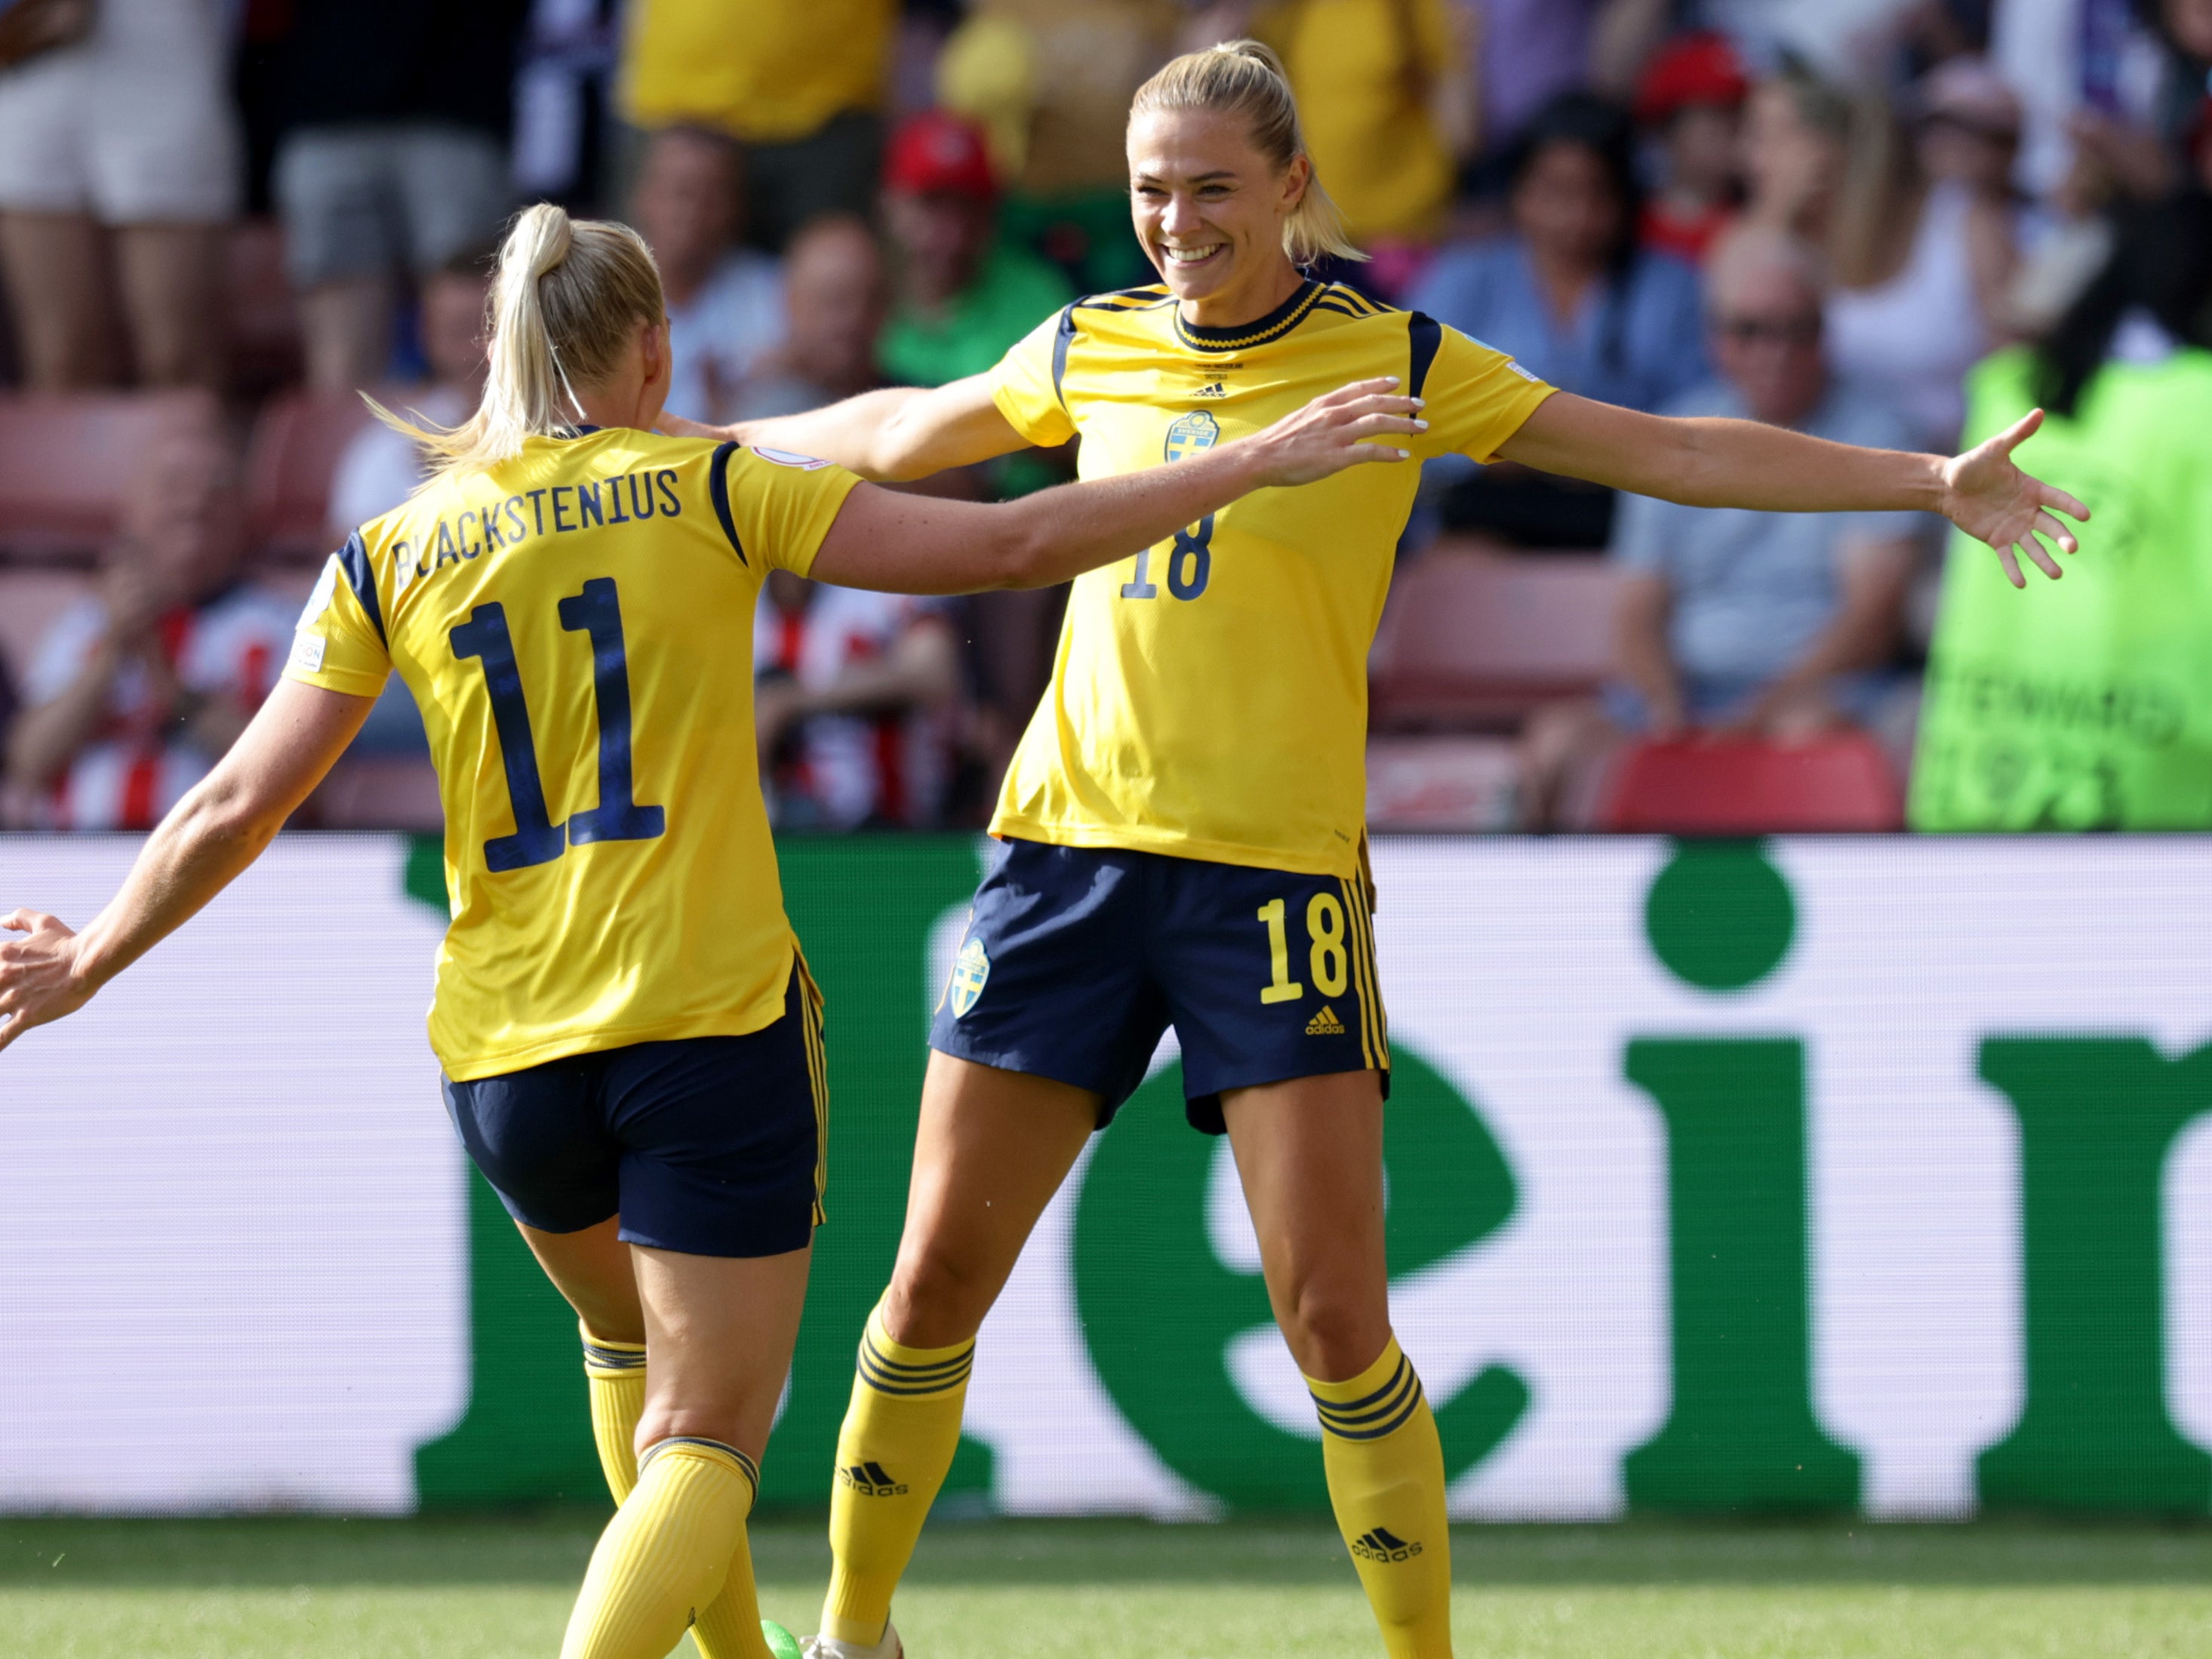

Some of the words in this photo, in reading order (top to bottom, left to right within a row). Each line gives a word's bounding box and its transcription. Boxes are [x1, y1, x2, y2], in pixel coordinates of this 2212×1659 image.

[1177, 428, 1210, 438] SVERIGE
[392, 469, 681, 589] BLACKSTENIUS
[1121, 513, 1215, 602] 18
[449, 577, 666, 873] 11
[1257, 892, 1347, 1005] 18
[1305, 1024, 1345, 1035] adidas
[1352, 1544, 1423, 1564] adidas
